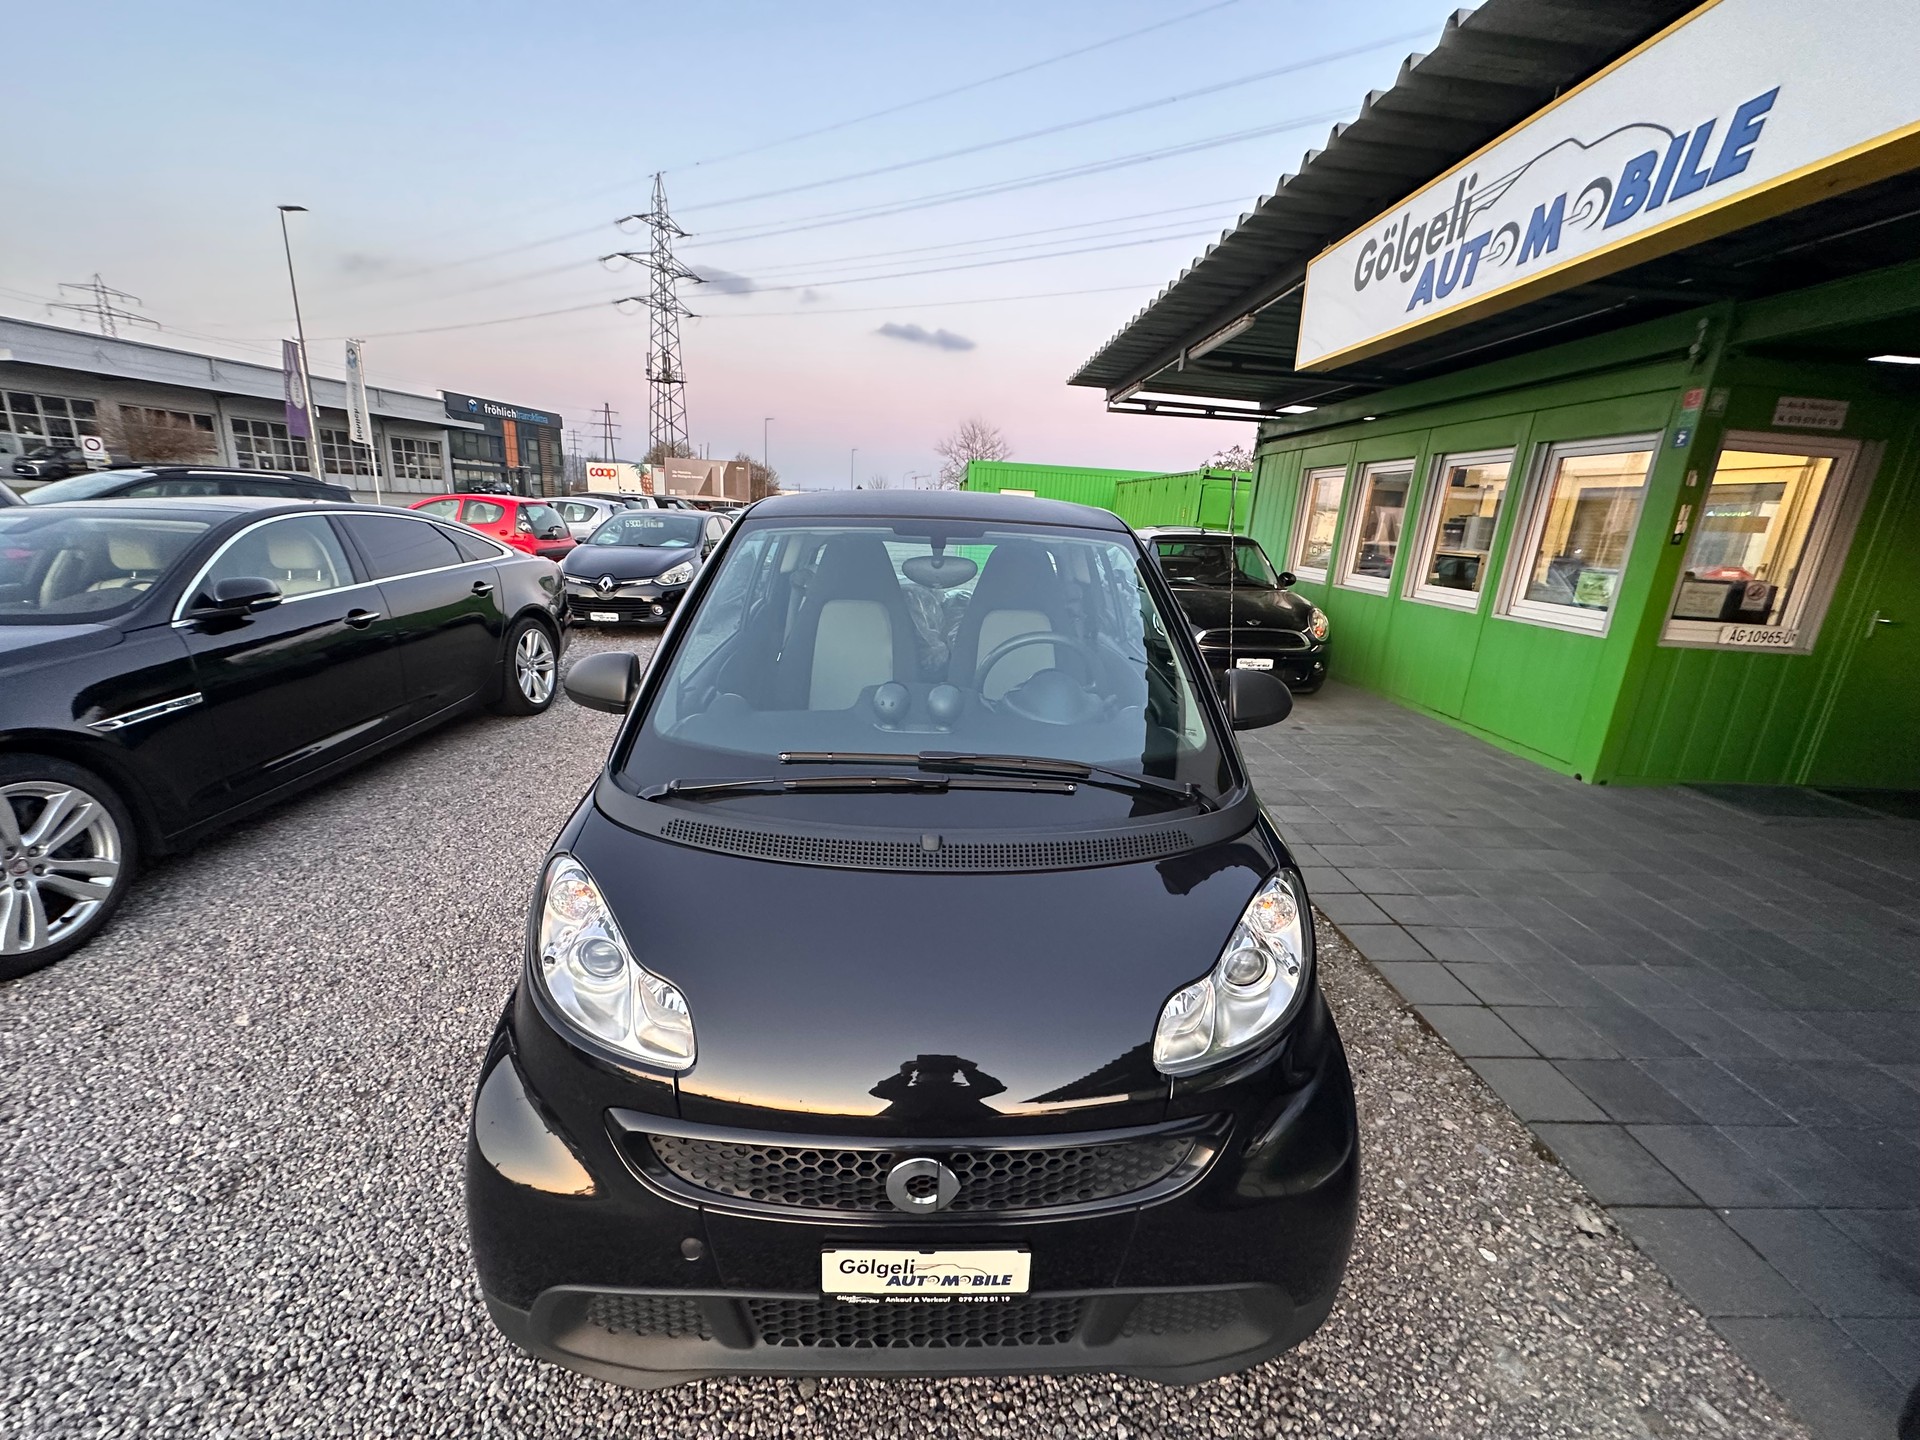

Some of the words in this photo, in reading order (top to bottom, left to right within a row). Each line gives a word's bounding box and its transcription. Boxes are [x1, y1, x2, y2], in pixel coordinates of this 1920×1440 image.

[1353, 175, 1478, 292] Gölgeli
[589, 467, 617, 480] coop
[839, 1259, 916, 1279] Gölgeli
